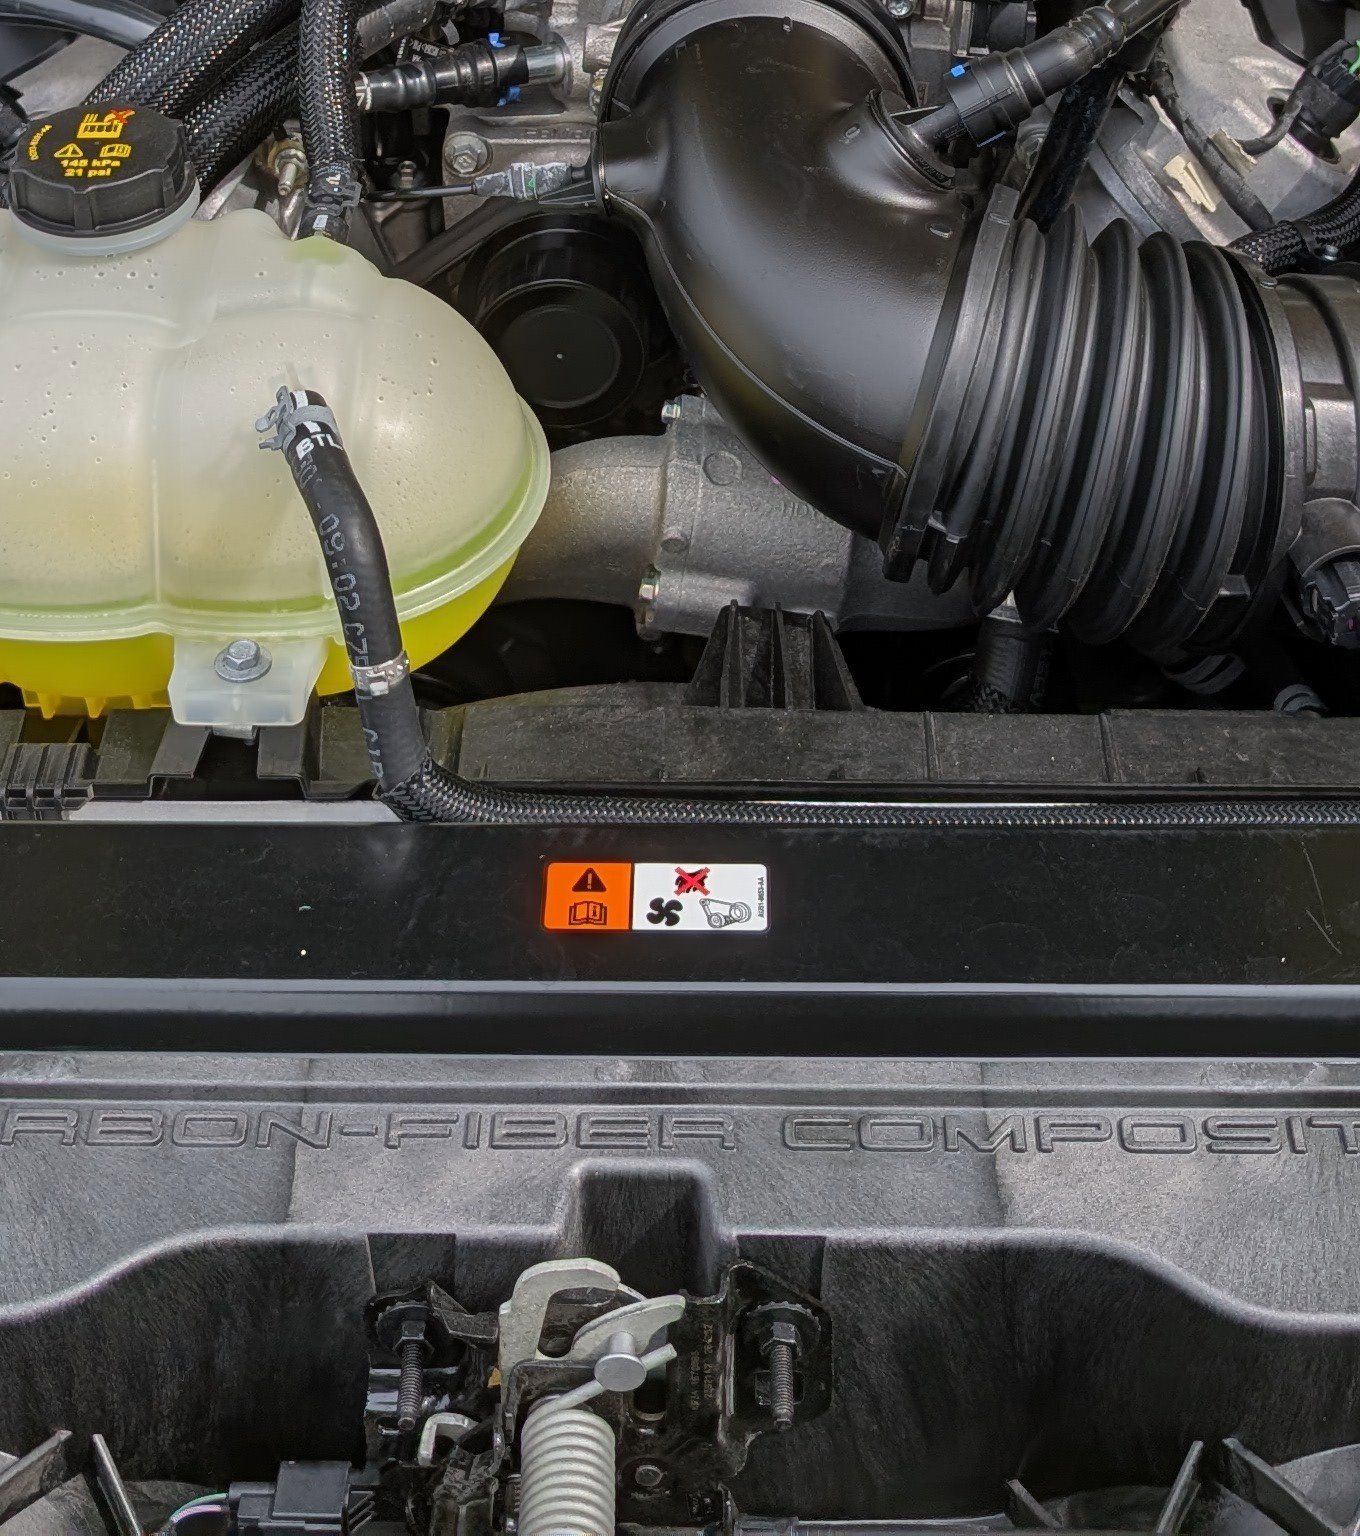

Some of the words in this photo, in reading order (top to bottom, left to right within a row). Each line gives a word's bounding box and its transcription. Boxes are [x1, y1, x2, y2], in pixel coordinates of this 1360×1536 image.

[91, 159, 121, 168] kPa
[63, 168, 82, 177] 21
[86, 168, 111, 178] psi
[295, 433, 342, 461] BTL
